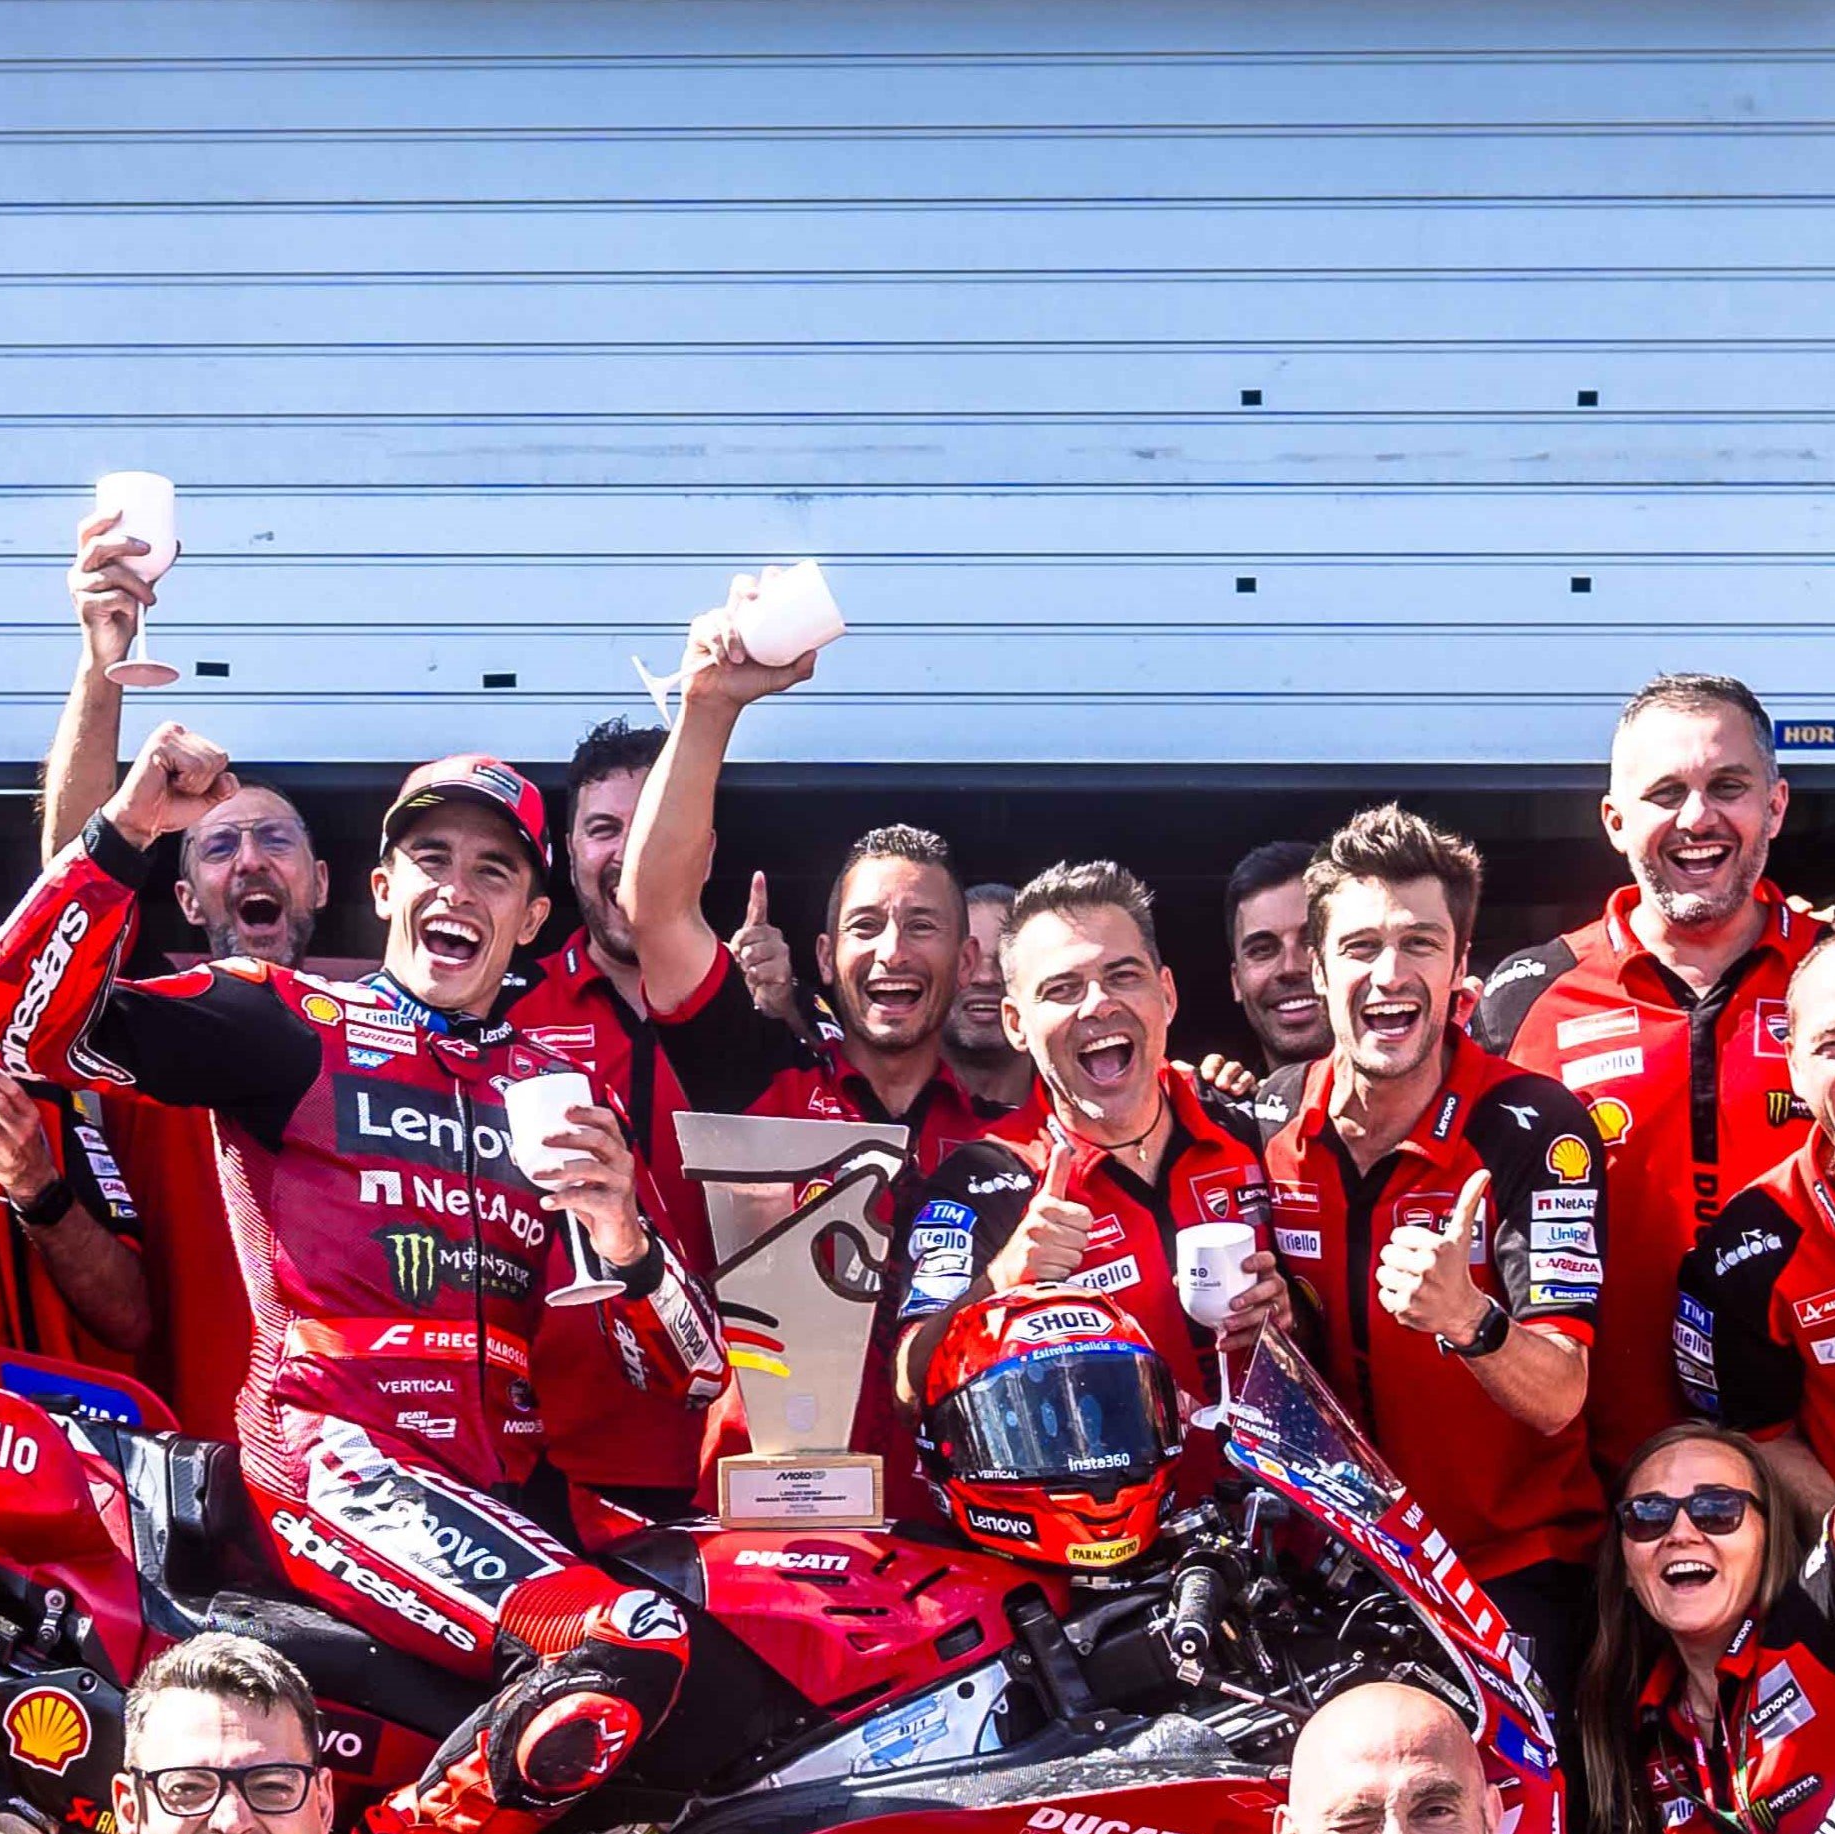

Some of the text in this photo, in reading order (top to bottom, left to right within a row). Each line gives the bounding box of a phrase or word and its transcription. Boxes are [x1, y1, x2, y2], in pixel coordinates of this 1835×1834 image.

[475, 766, 518, 792] Lenovo
[398, 996, 430, 1025] TIM
[349, 1029, 413, 1047] CARRERA
[350, 1050, 381, 1066] SAP
[357, 1092, 514, 1158] Leno
[1435, 1096, 1457, 1138] Lenovo
[932, 1206, 965, 1224] TIM
[1286, 1234, 1317, 1251] riello
[1715, 1230, 1783, 1276] diadora
[440, 1247, 530, 1288] MONSTER
[1536, 1258, 1599, 1274] CARRERA
[1028, 1312, 1101, 1336] SHOEI
[1682, 1300, 1705, 1326] TIM
[1033, 1341, 1111, 1360] Estrella Galicia
[378, 1379, 454, 1393] VERTICAL
[978, 1470, 1019, 1479] VERTICAL
[1069, 1453, 1130, 1472] Insta360
[969, 1511, 1031, 1535] Lenovo
[734, 1550, 850, 1572] DUCATI
[272, 1510, 476, 1652] alpinestars
[1729, 1619, 1752, 1653] Lenovo
[1751, 1688, 1795, 1724] Lenovo
[1770, 1775, 1818, 1809] MONSTER
